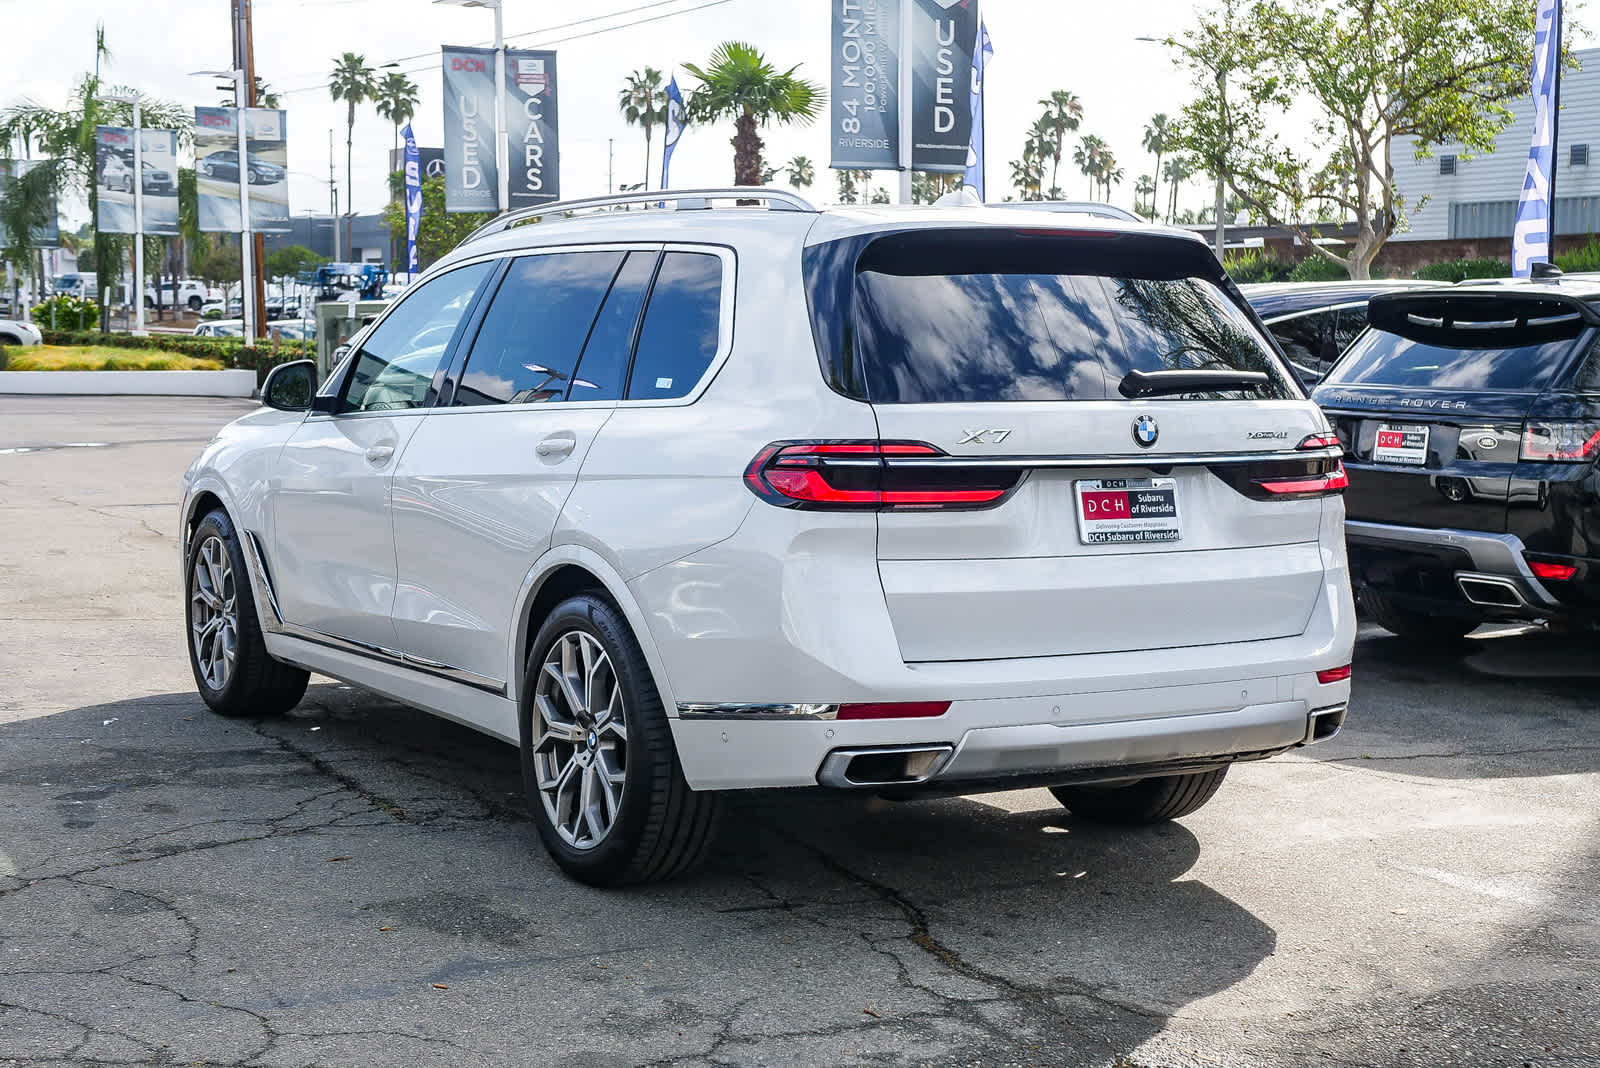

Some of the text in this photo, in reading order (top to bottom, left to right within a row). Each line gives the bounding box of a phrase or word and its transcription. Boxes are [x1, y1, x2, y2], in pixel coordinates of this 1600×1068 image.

[451, 57, 486, 72] DCH
[864, 41, 877, 112] 100,000
[934, 19, 955, 133] USED
[202, 115, 231, 127] DCH
[842, 98, 861, 134] 84
[103, 132, 128, 144] DCH
[460, 95, 481, 189] USED
[524, 97, 544, 191] CARS
[839, 138, 890, 149] RIVERSIDE
[1335, 395, 1467, 409] RANGE ROVER
[956, 429, 1012, 445] X7
[1380, 435, 1400, 445] DCH
[1138, 493, 1164, 502] Subaru
[1088, 498, 1124, 513] DCH
[1131, 503, 1174, 514] of Riverside
[1088, 530, 1179, 542] DCH Subaru of Riverside
